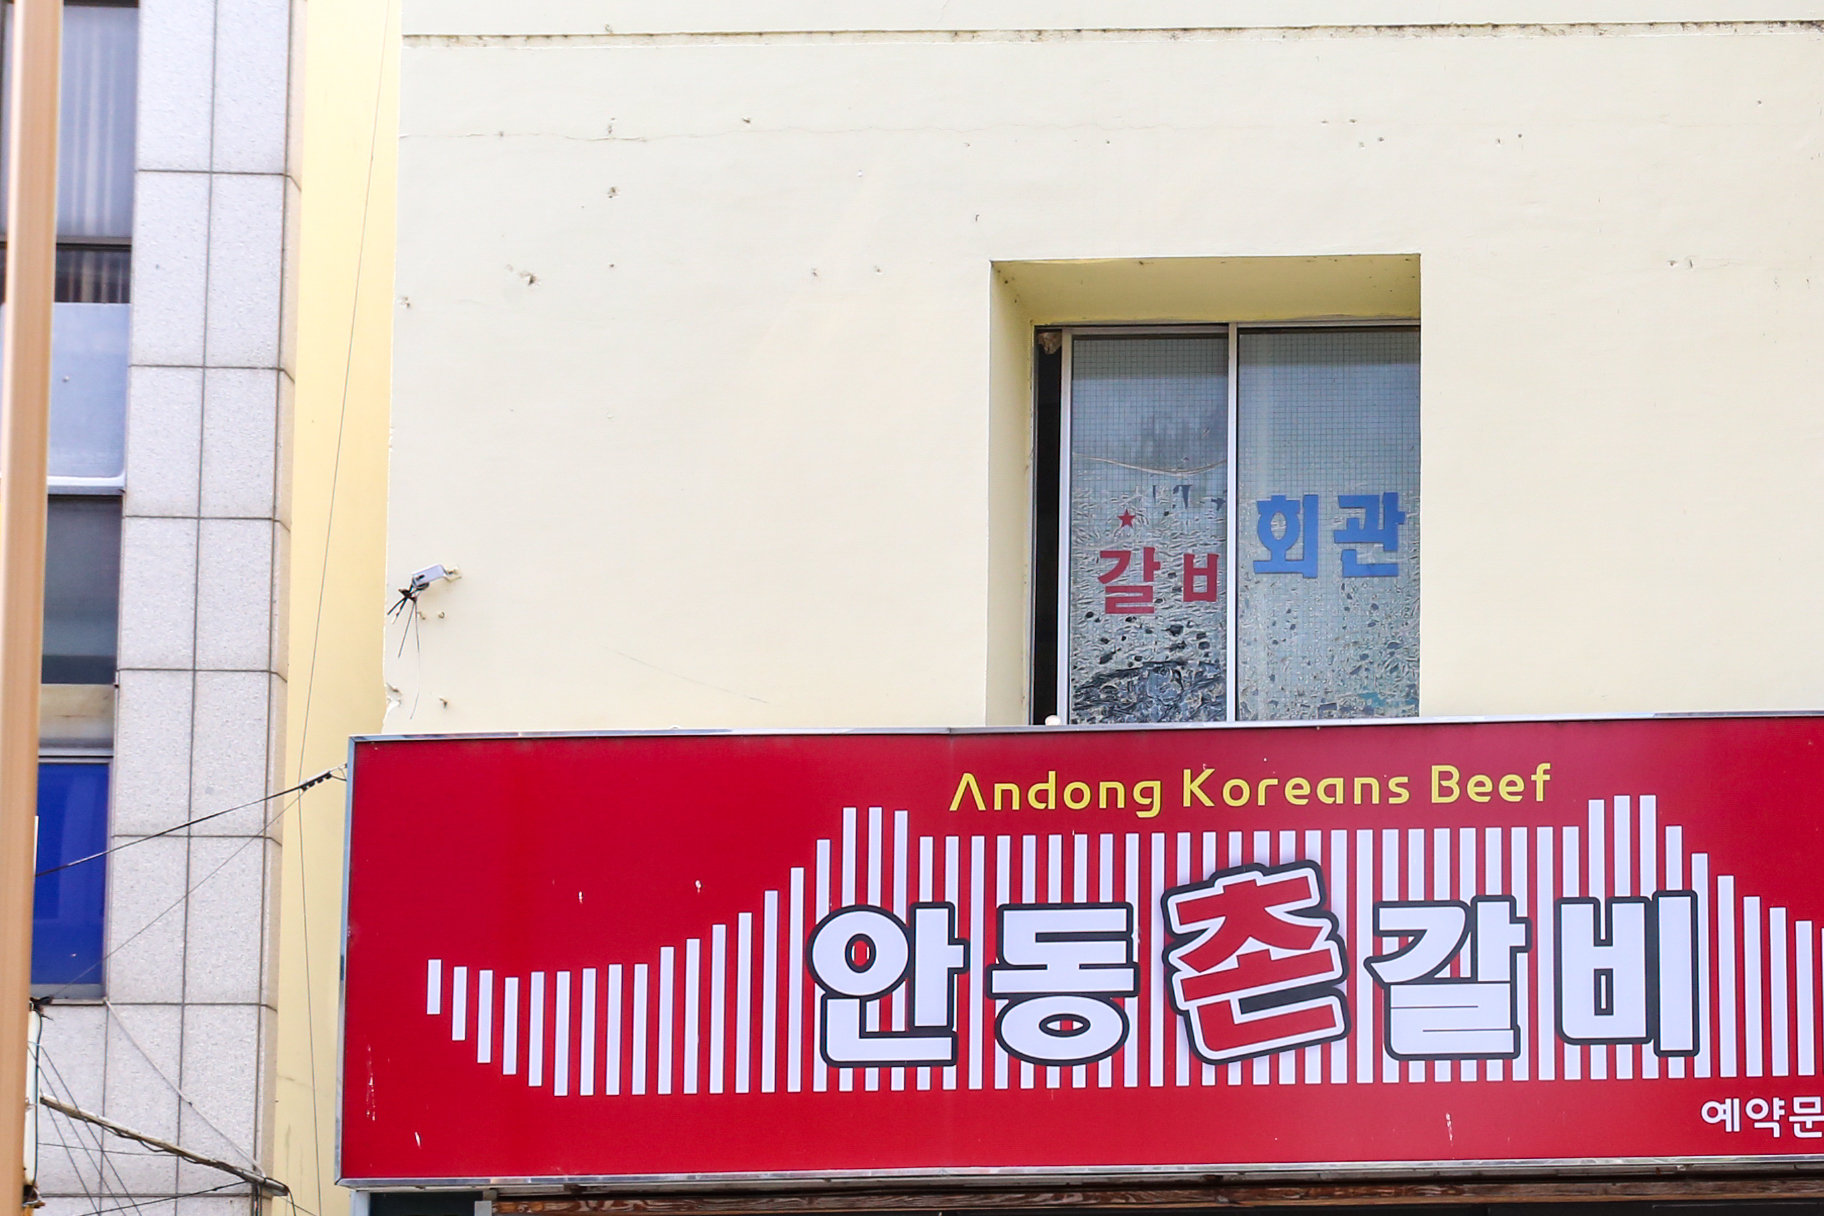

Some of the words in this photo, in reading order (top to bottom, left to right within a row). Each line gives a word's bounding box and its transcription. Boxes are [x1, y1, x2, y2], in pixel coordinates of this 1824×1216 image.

[1252, 491, 1406, 579] 회관
[1098, 546, 1219, 615] 갈비
[949, 769, 1161, 818] Andong
[1183, 767, 1410, 808] Koreans
[1430, 762, 1552, 803] Beef
[806, 858, 1699, 1069] 안동촌갈비
